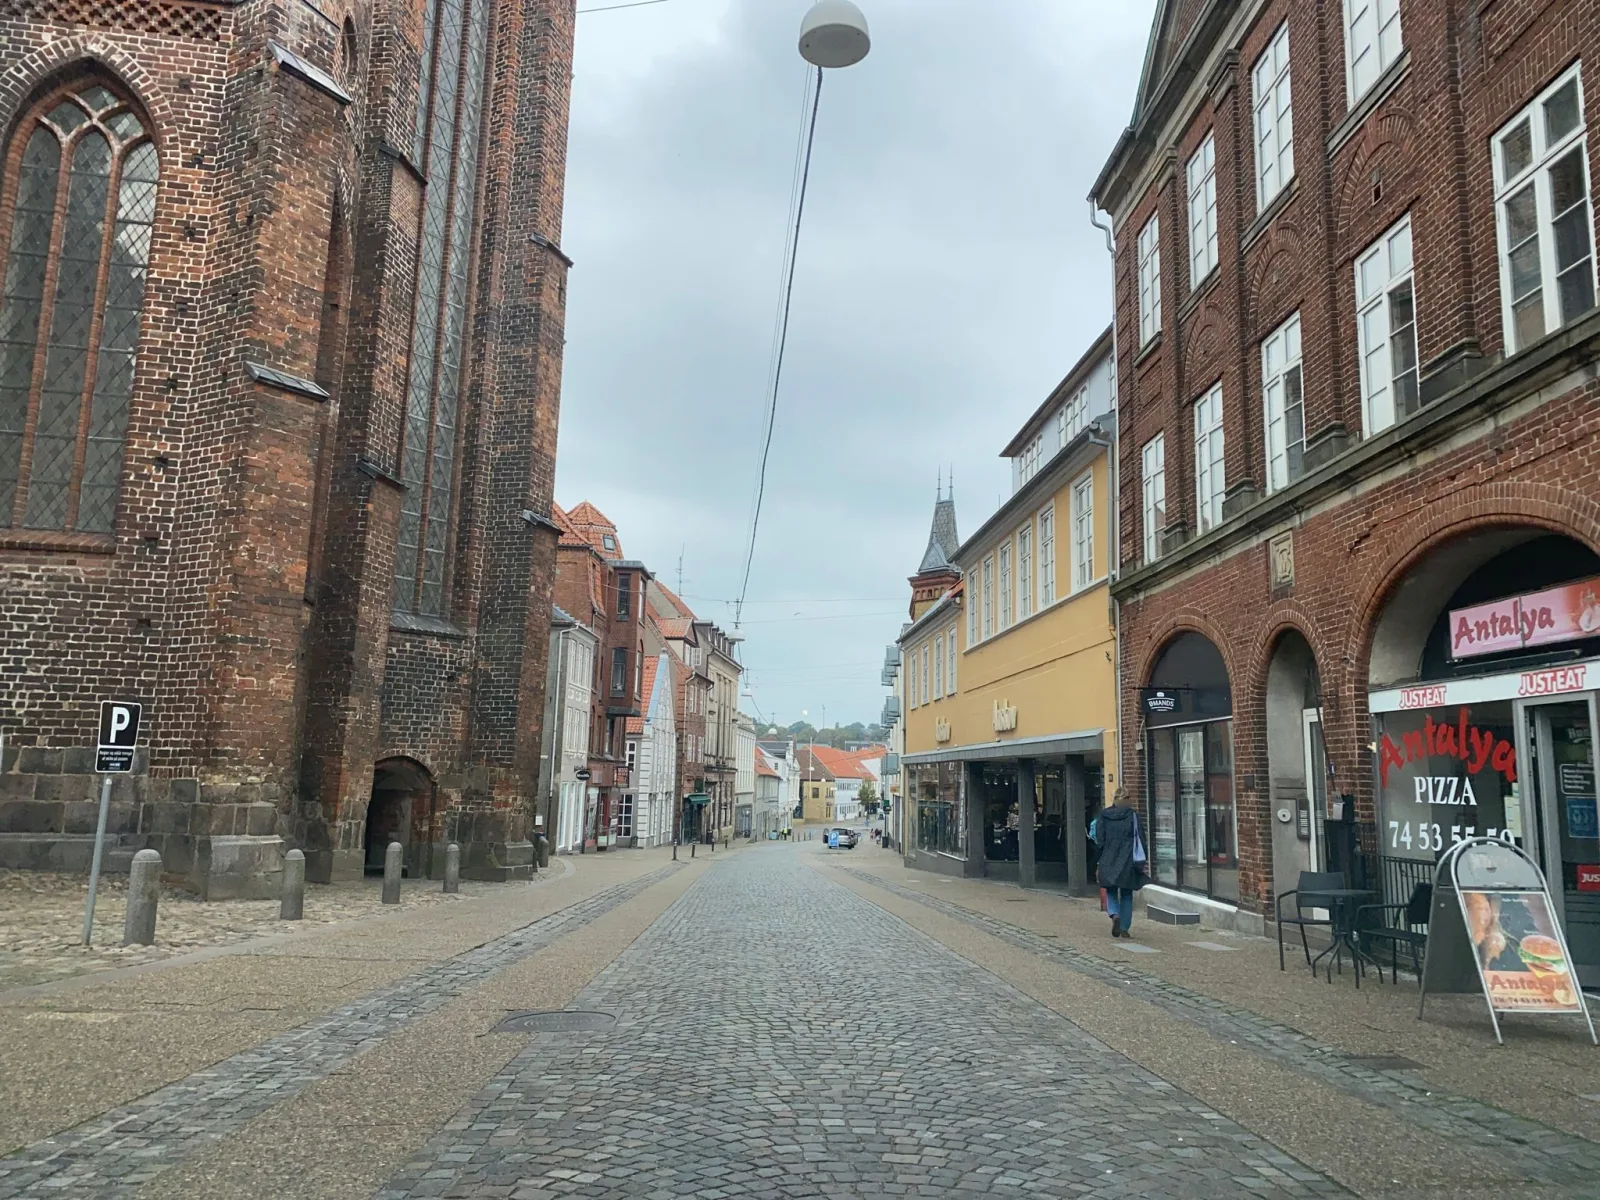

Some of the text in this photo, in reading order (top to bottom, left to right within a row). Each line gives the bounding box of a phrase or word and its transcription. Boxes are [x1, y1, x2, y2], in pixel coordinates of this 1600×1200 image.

[1454, 600, 1555, 649] Antalya
[1519, 666, 1586, 695] JUST EAT
[1400, 686, 1447, 708] JUST EAT
[109, 706, 130, 743] P
[1380, 706, 1516, 789] Antalya
[1413, 776, 1478, 805] PIZZA
[1389, 821, 1412, 850] 74
[1418, 822, 1443, 852] 53
